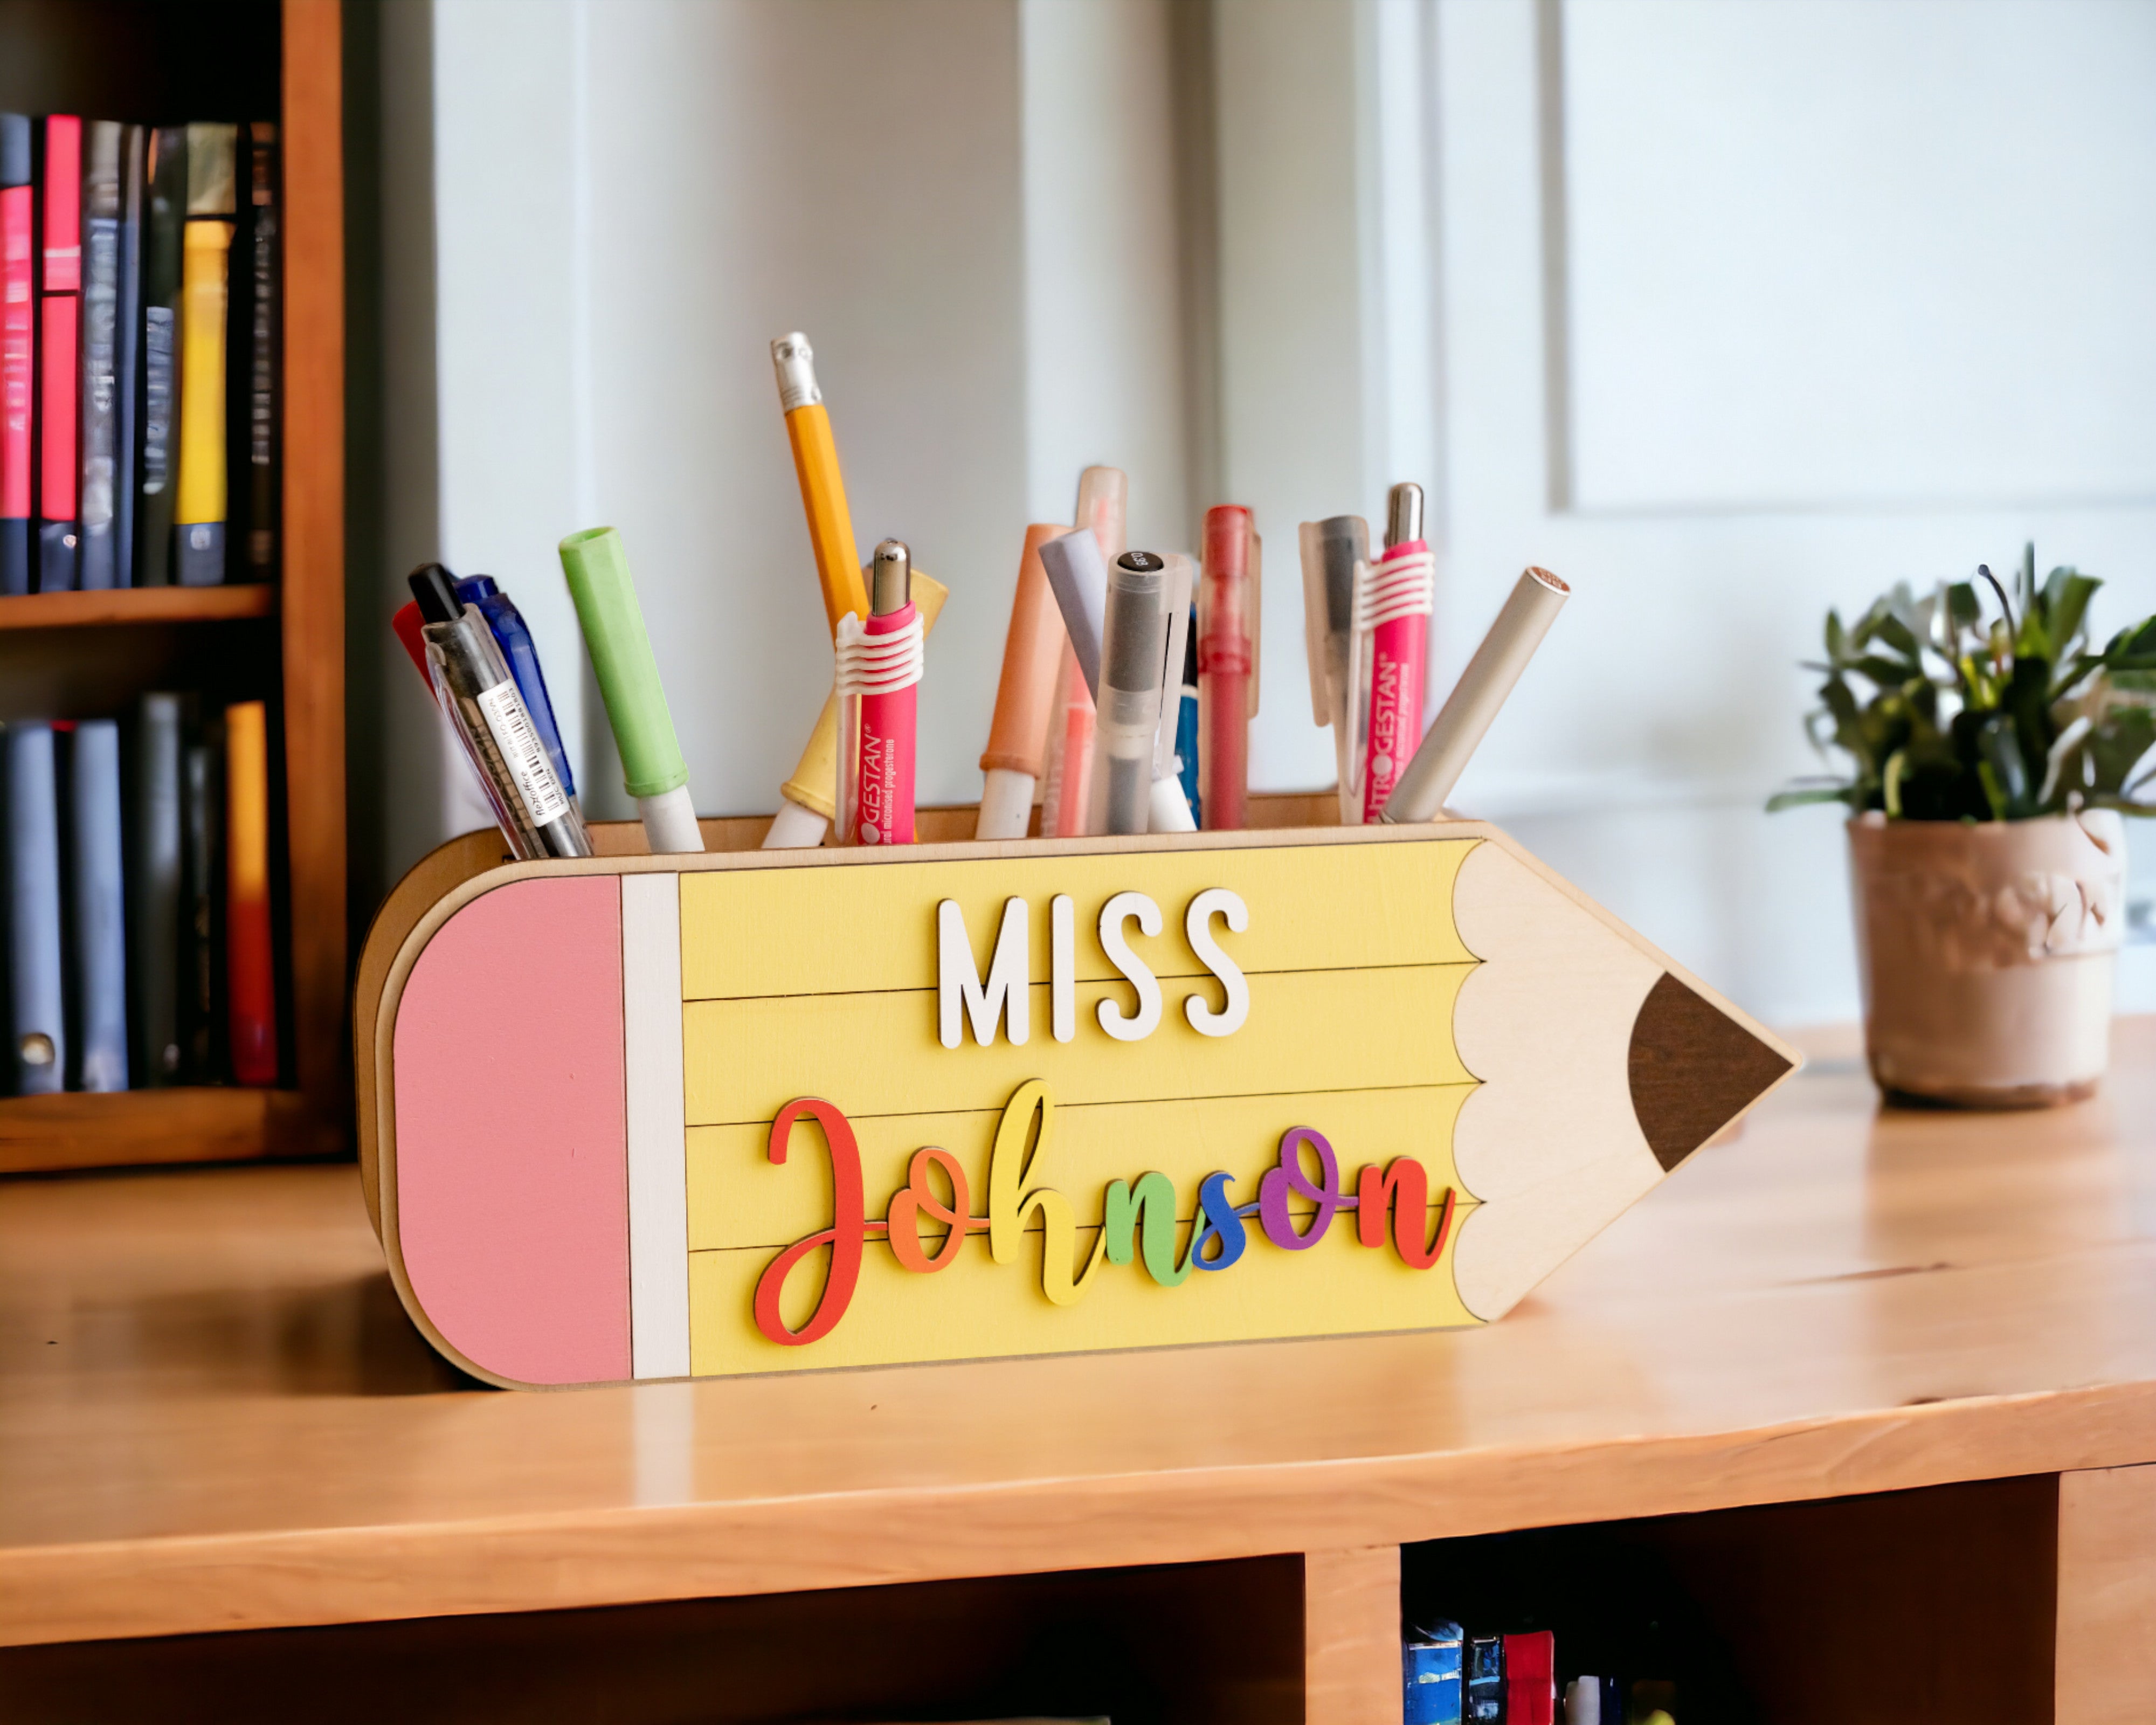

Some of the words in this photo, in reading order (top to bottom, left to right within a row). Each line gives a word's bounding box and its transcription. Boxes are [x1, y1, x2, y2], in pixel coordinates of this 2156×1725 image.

[882, 790, 893, 829] micronised
[883, 739, 896, 788] progesterone
[937, 887, 1249, 1049] MISS
[754, 1078, 1456, 1346] Johnson
